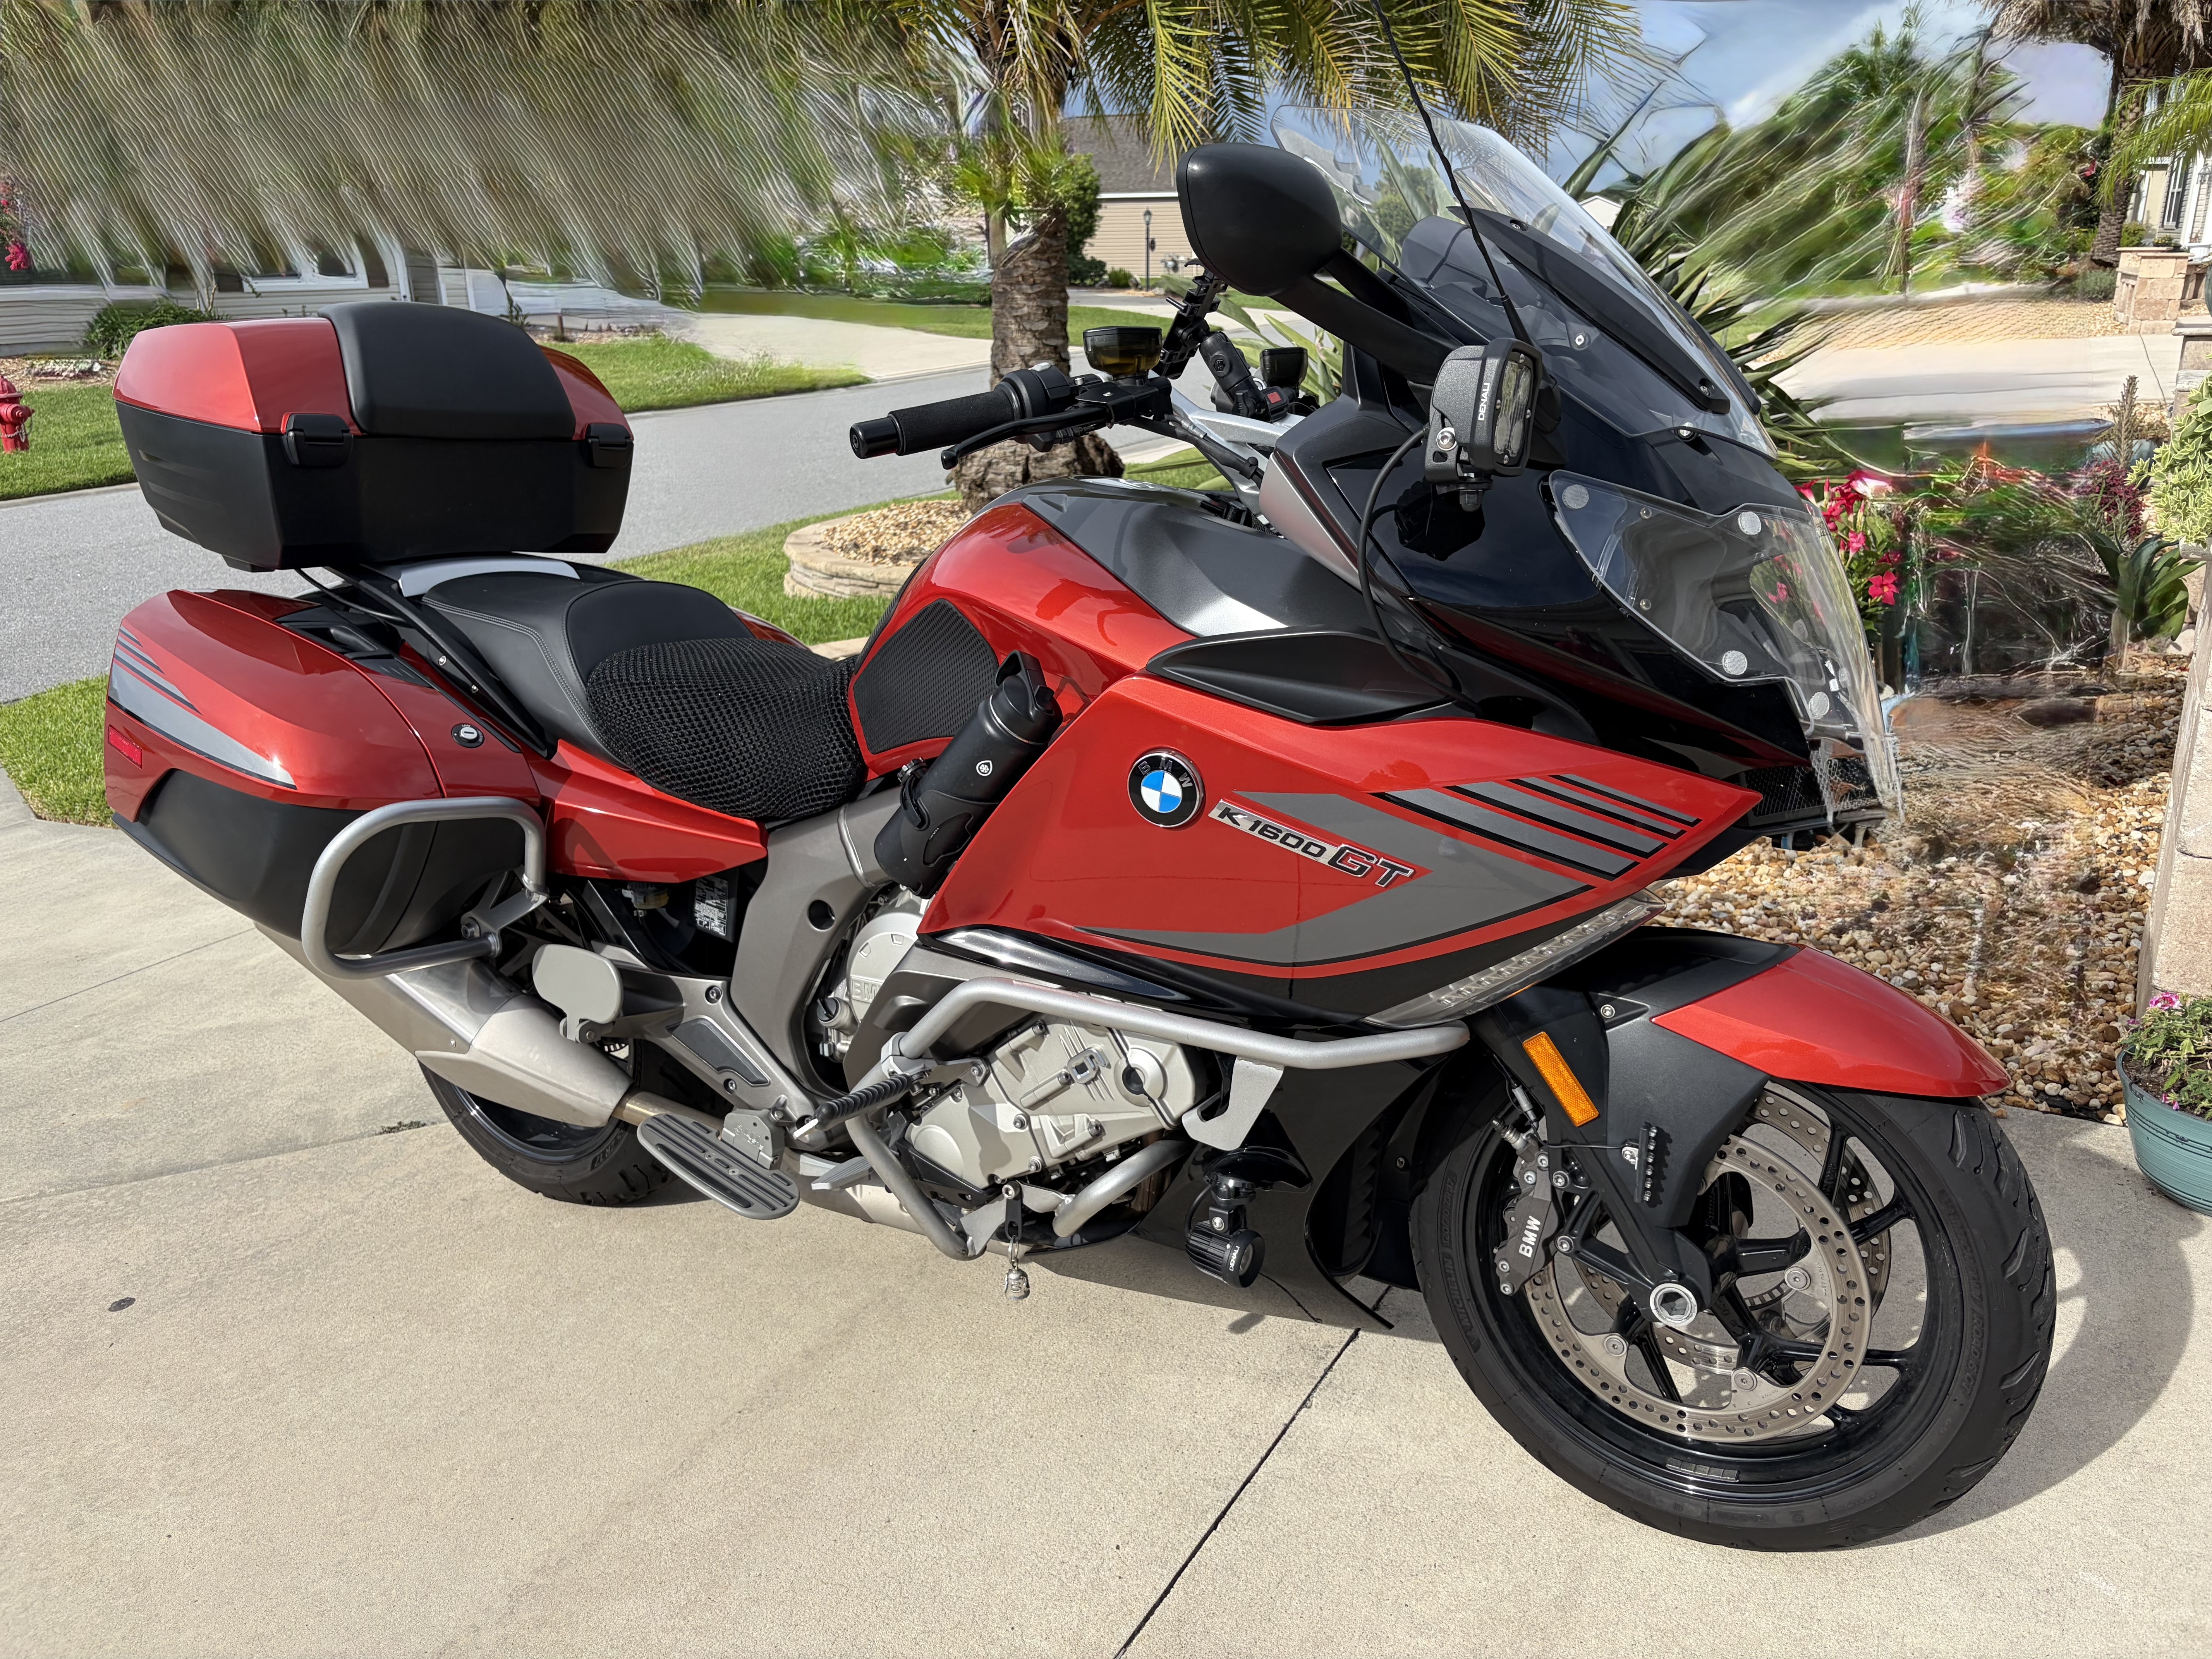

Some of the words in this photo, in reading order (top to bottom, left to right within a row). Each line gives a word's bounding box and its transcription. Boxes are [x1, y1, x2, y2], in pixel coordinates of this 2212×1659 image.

[1478, 383, 1491, 421] DENALI
[1138, 758, 1193, 788] BMW
[1217, 806, 1247, 827] K
[1248, 819, 1328, 858] 1600
[1327, 843, 1415, 888] GT
[852, 979, 881, 1001] BM
[1442, 1209, 1450, 1247] 120/70
[1518, 1215, 1540, 1258] BMW
[1229, 1245, 1240, 1271] DENALI
[1444, 1257, 1471, 1326] MICHELIN
